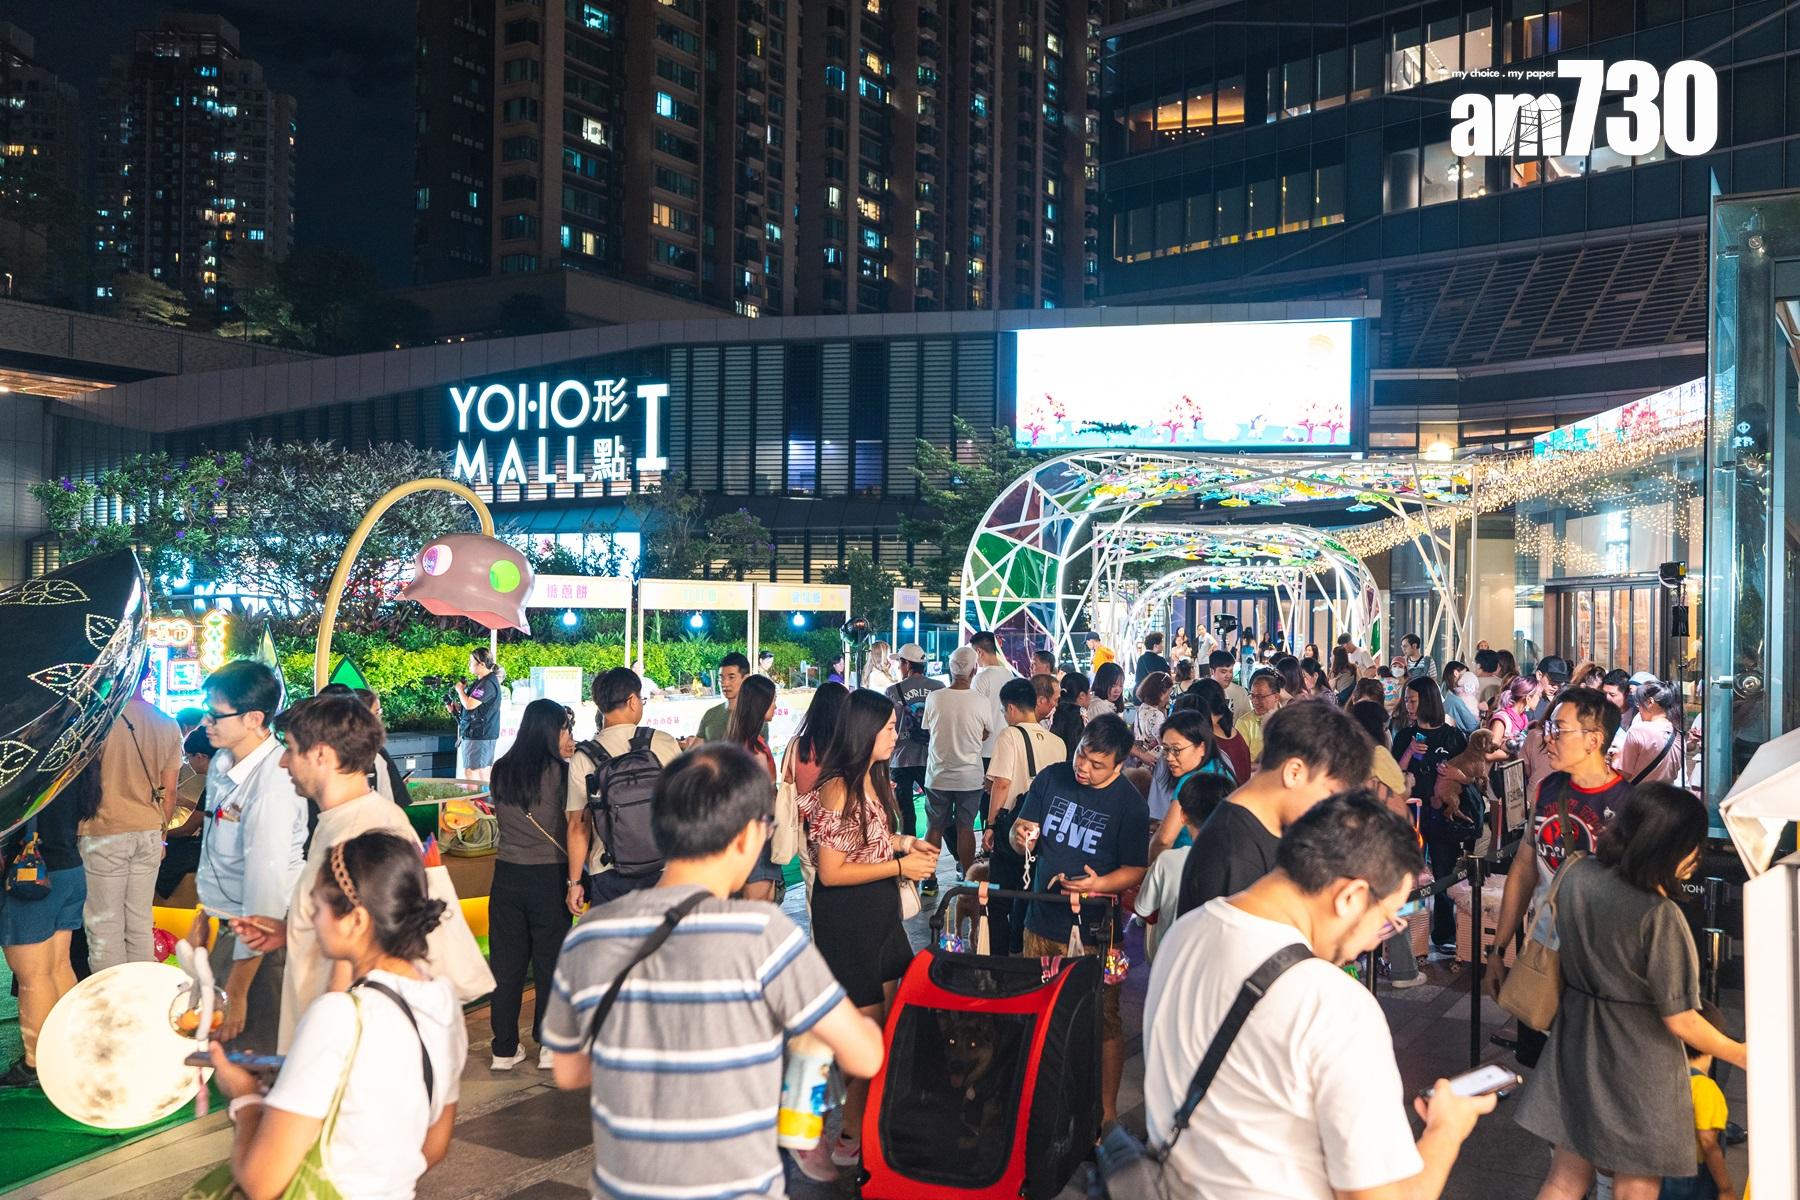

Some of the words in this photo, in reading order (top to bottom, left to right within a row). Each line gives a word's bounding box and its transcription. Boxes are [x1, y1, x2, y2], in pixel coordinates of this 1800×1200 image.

[450, 380, 591, 433] YOHO
[453, 436, 587, 485] MALL
[1681, 883, 1706, 894] YOH
